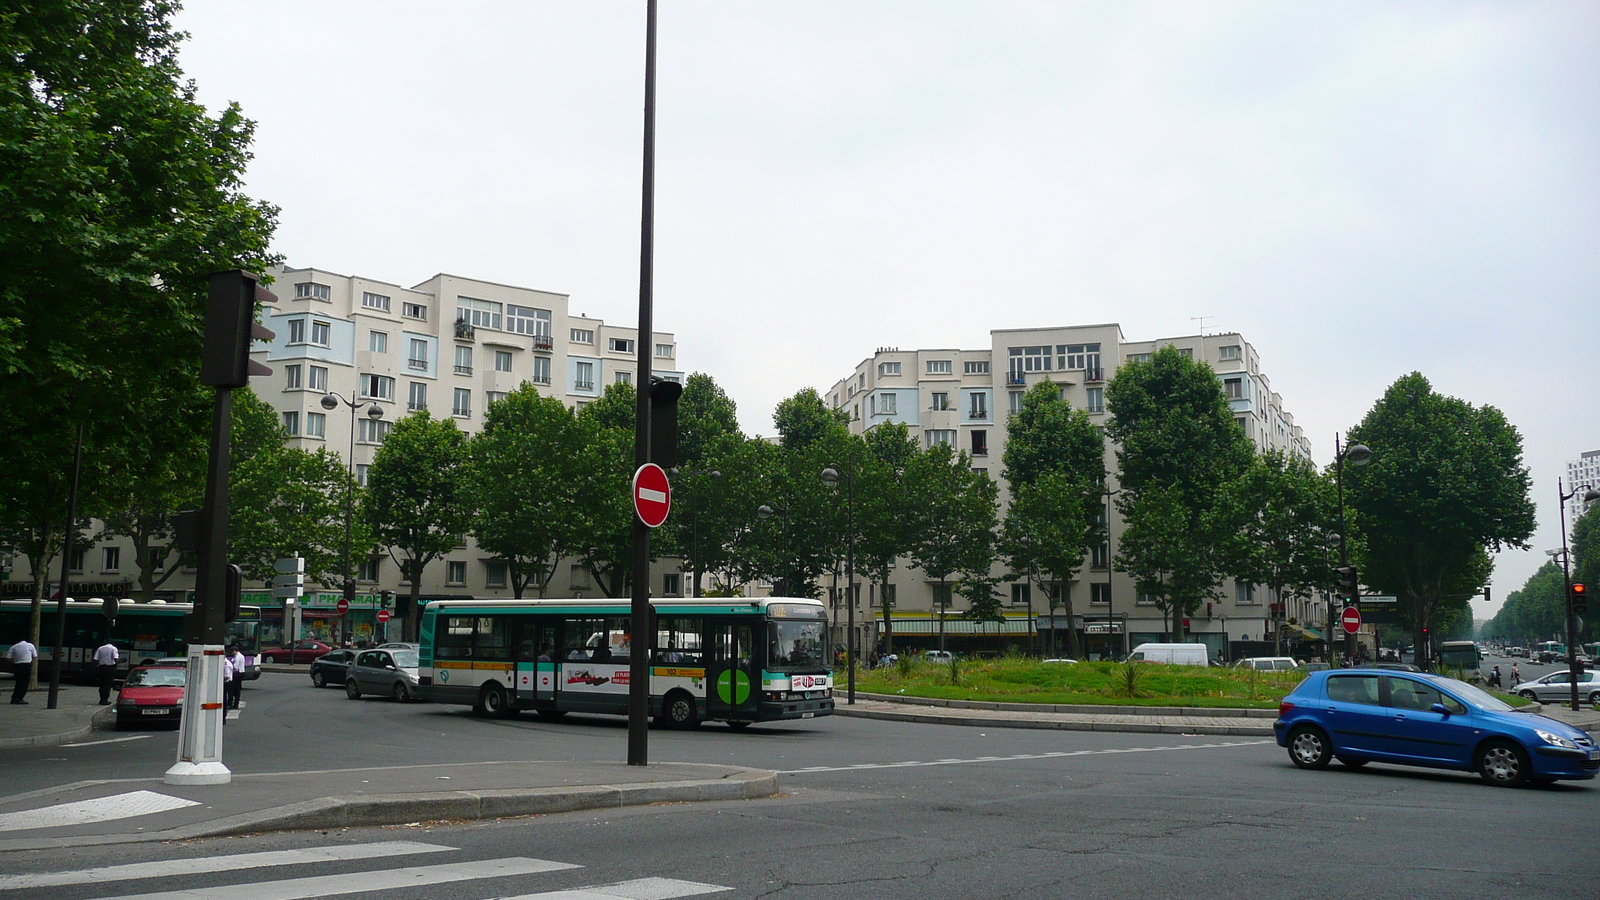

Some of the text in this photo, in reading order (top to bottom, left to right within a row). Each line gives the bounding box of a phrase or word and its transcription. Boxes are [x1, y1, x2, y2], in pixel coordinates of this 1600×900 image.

[70, 584, 123, 593] TATAMIS
[318, 594, 393, 604] PHAMACE
[666, 668, 677, 676] 102
